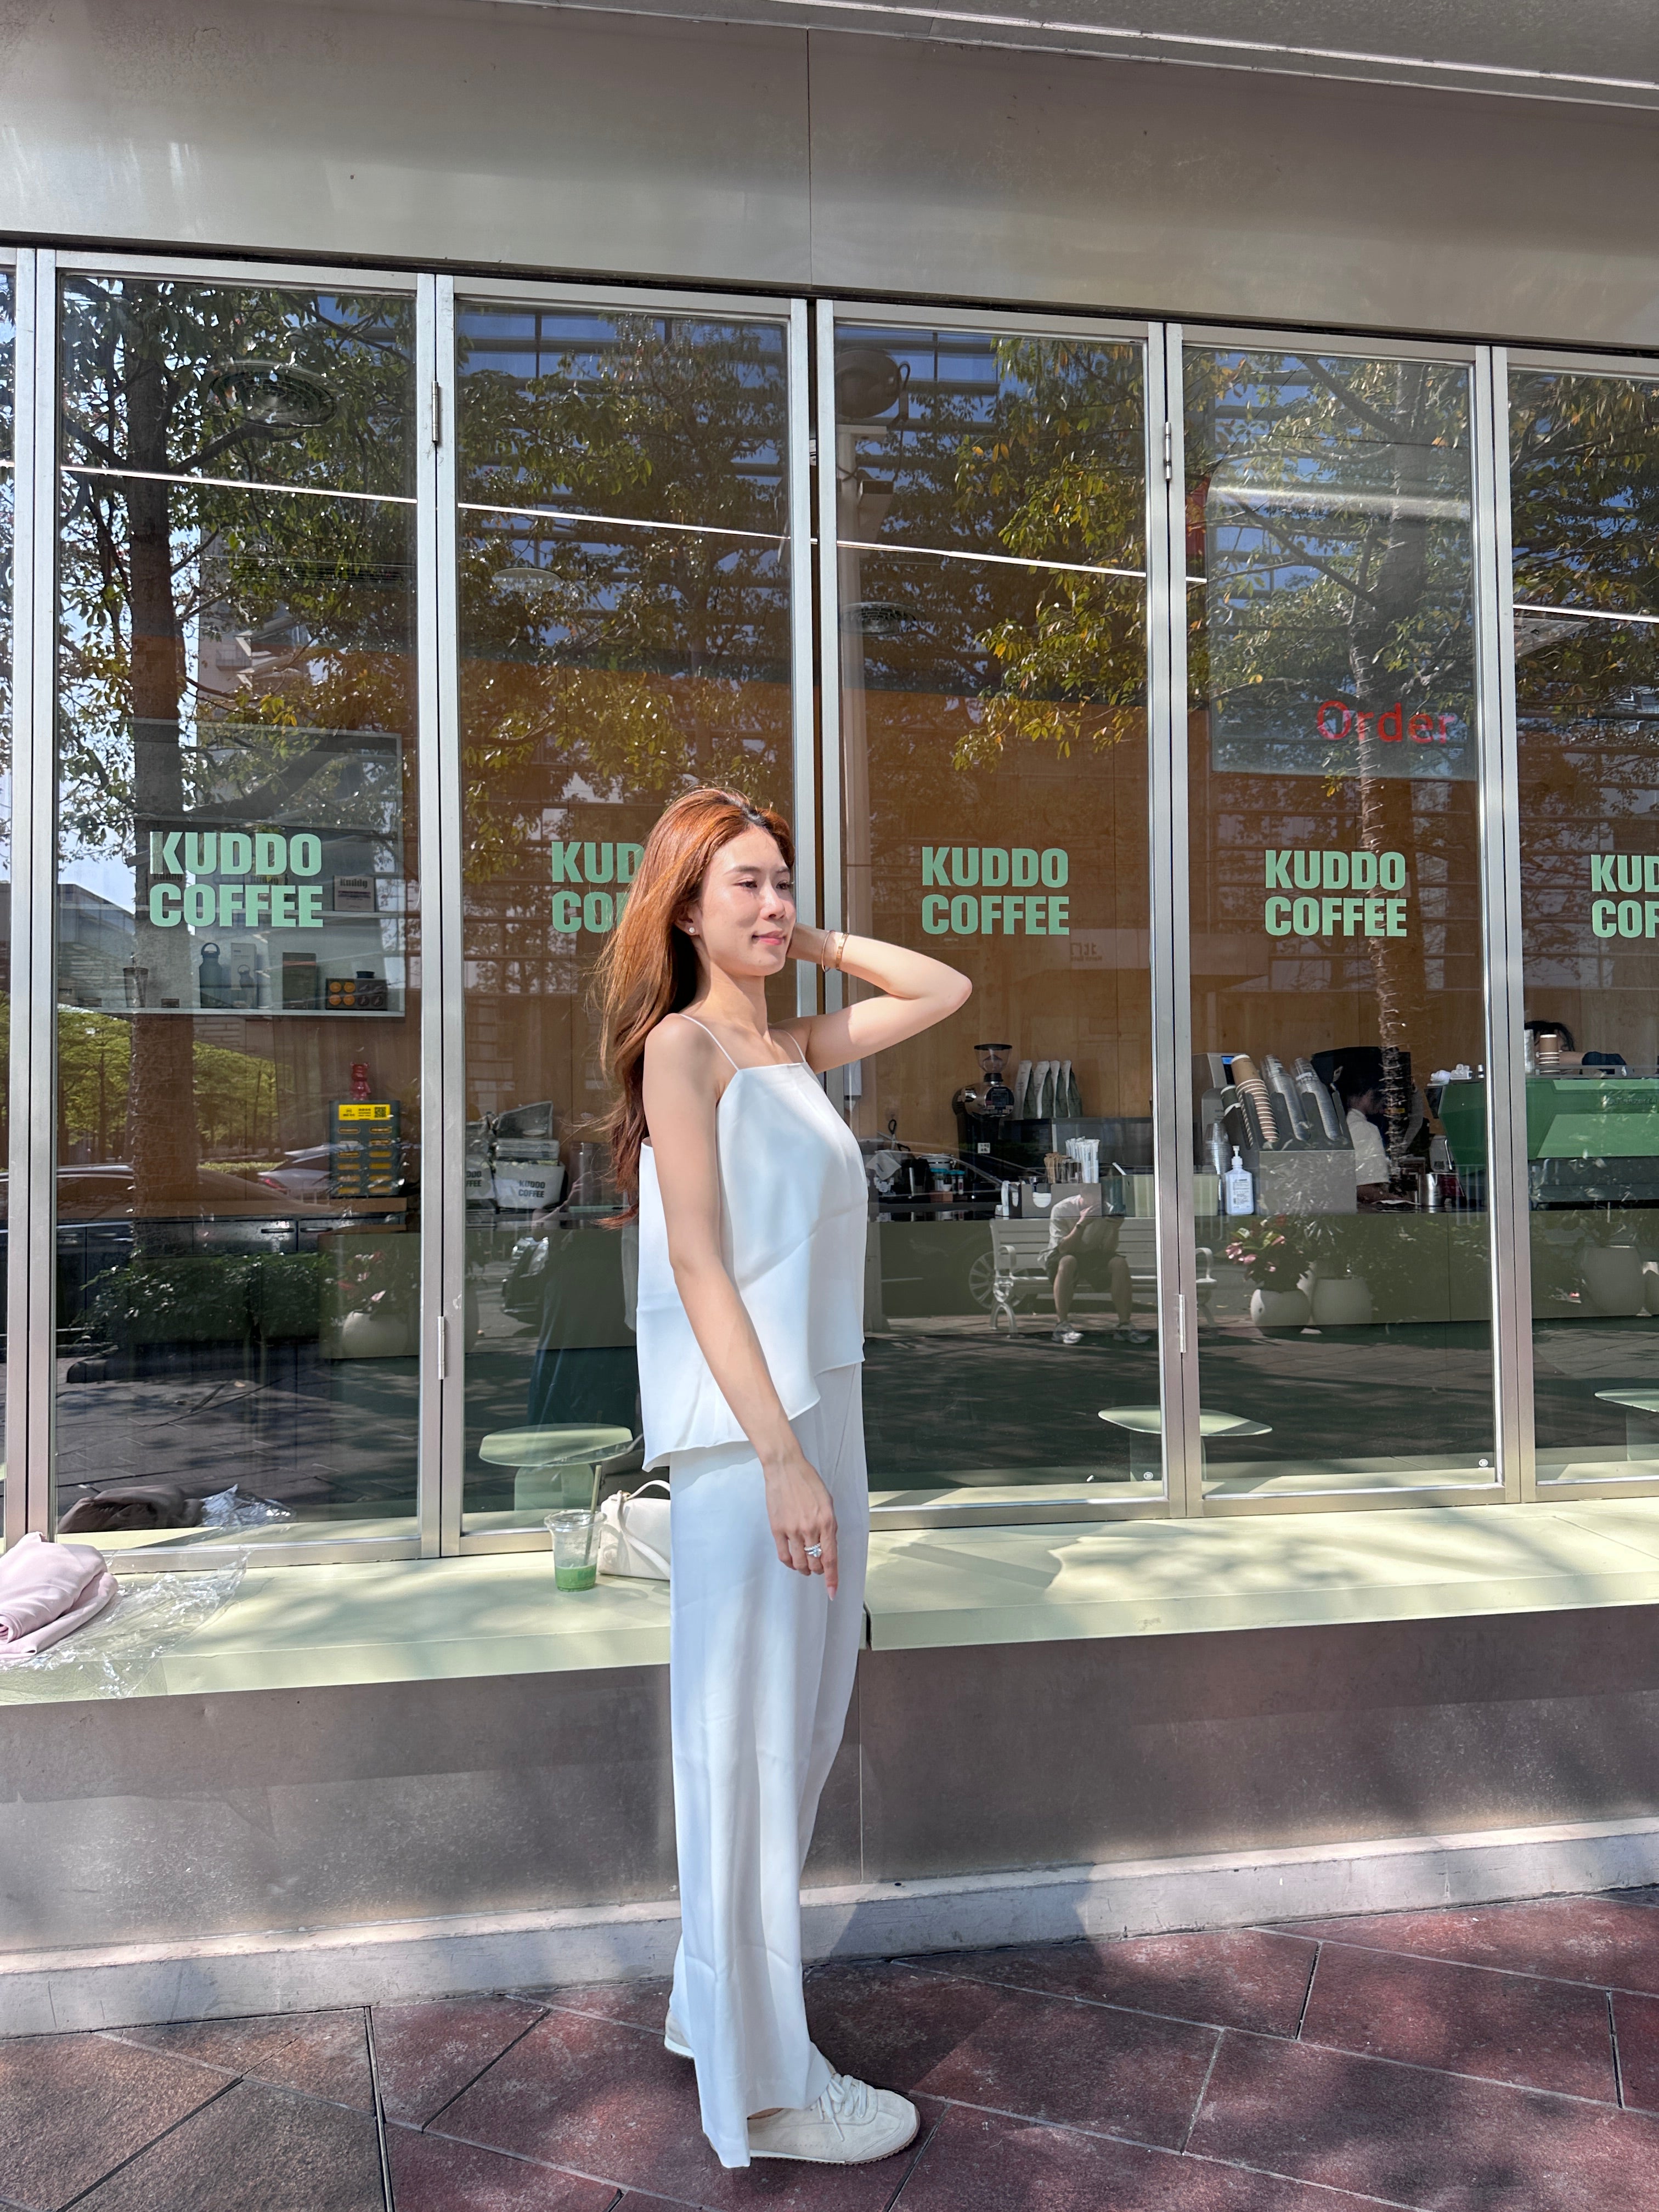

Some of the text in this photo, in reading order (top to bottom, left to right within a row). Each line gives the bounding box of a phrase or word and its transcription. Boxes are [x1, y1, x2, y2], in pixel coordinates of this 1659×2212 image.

[1317, 700, 1455, 744] Order
[150, 832, 322, 876] KUDDO
[551, 841, 645, 884] KUD
[922, 847, 1069, 888] KUDDO
[1265, 850, 1406, 891] KUDDO
[150, 883, 324, 928] COFFEE
[922, 894, 1069, 935] COFFEE
[1265, 896, 1407, 937] COFFEE
[518, 1189, 545, 1198] COFFEE
[519, 1180, 545, 1189] KUDDO
